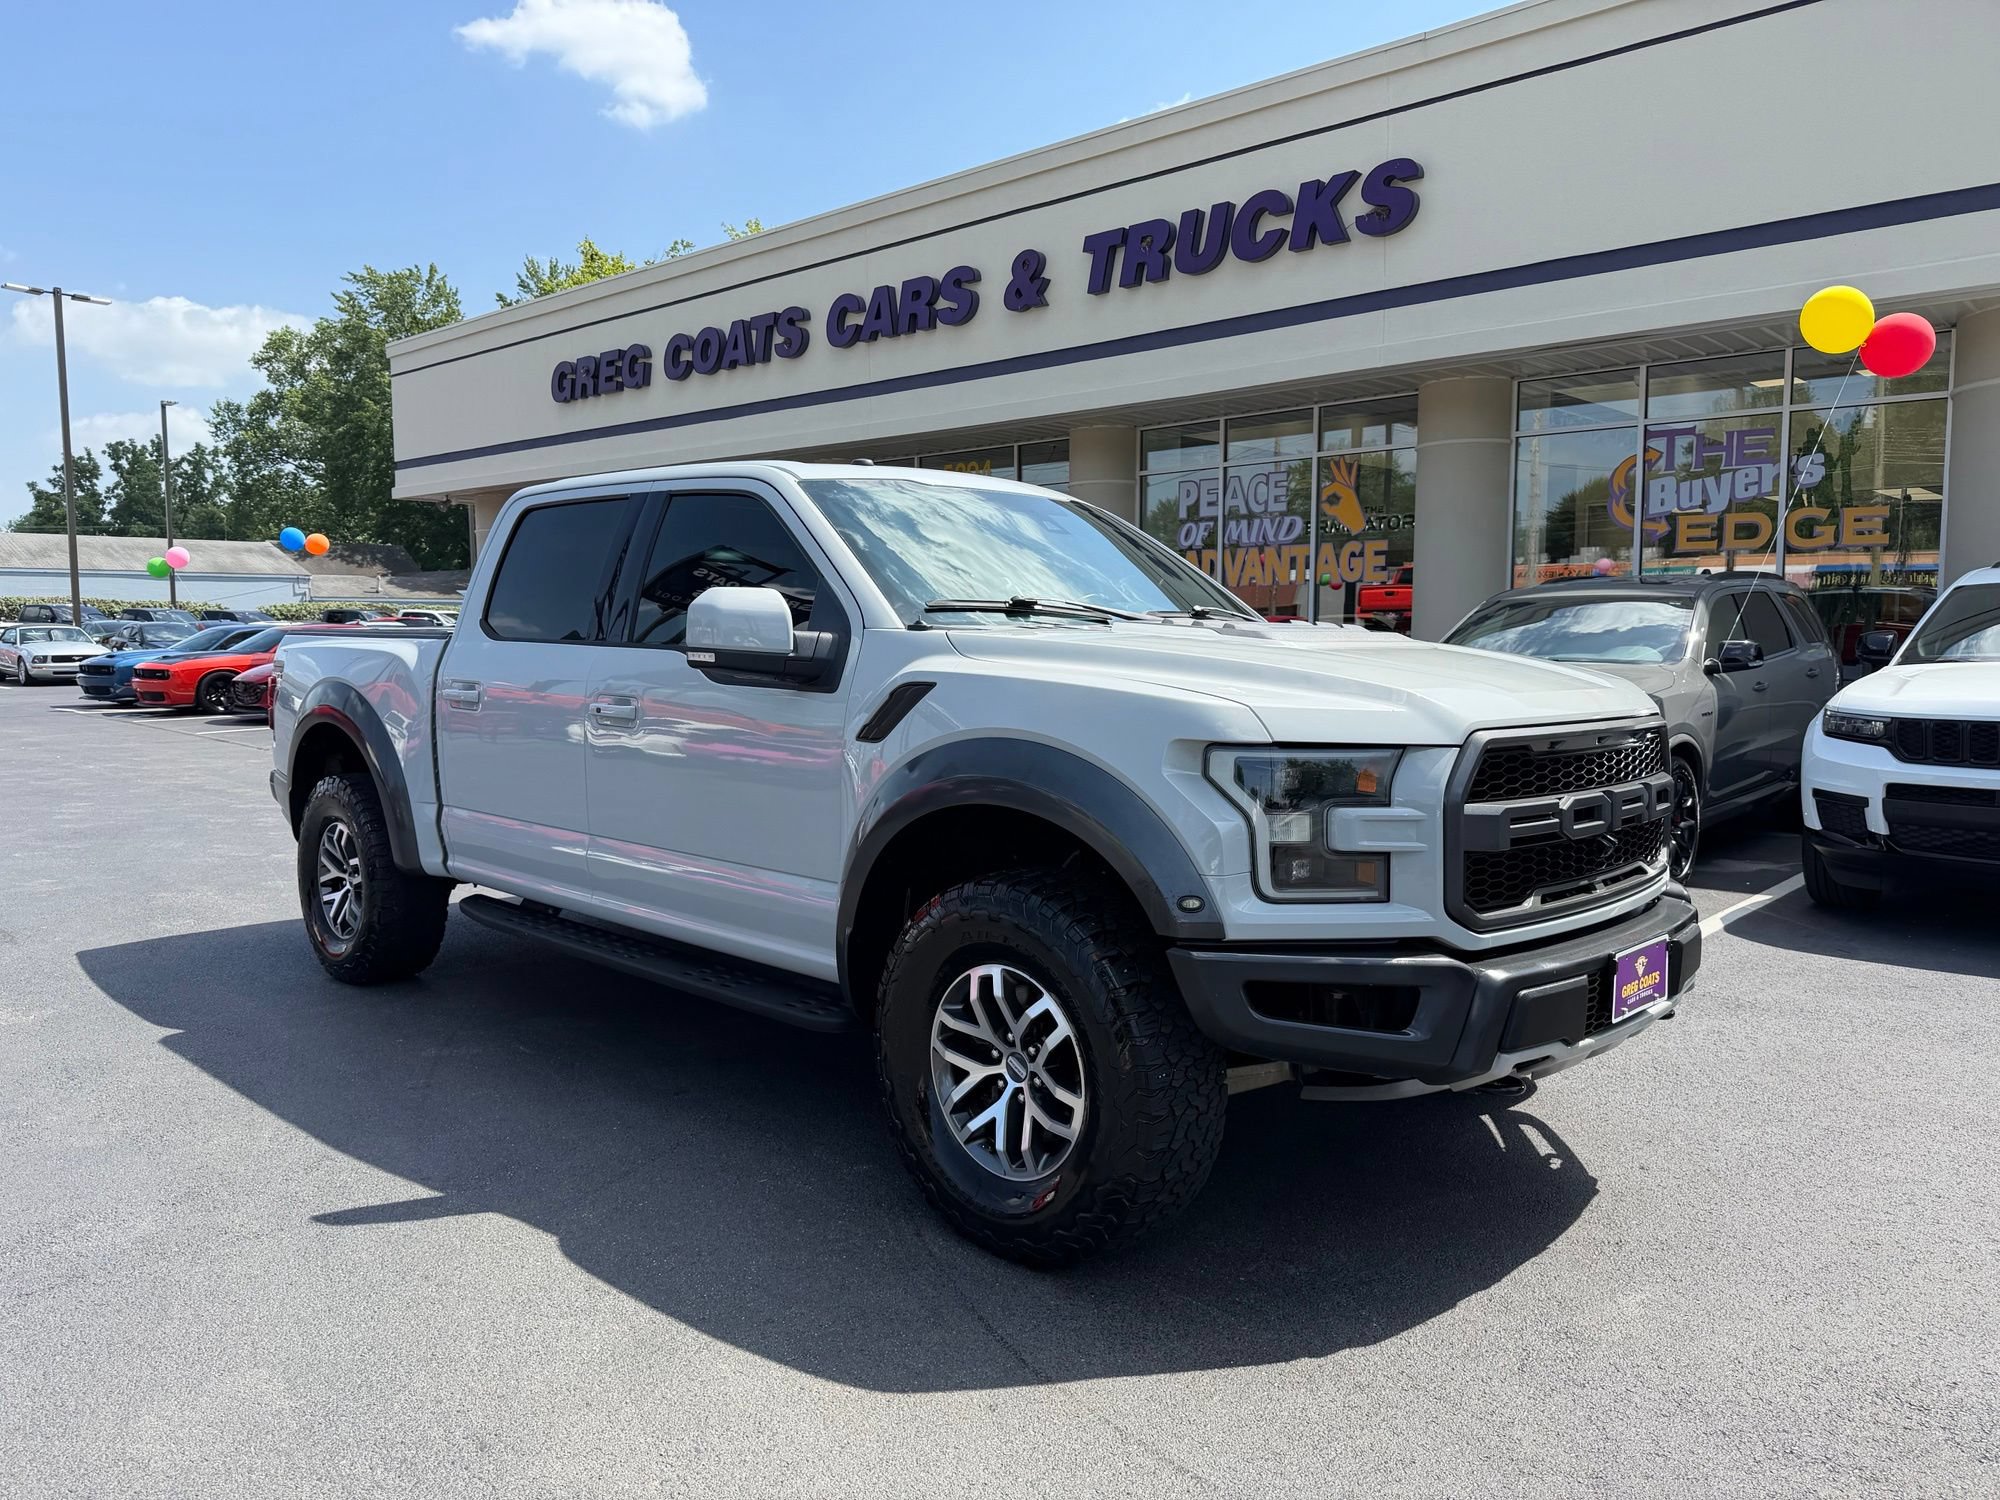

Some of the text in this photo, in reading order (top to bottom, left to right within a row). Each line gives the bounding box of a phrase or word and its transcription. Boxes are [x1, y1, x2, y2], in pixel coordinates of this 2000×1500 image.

[551, 158, 1425, 403] GREG COATS CARS & TRUCKS
[1646, 425, 1776, 474] THE
[1178, 471, 1288, 520] PEACE
[1178, 516, 1304, 549] OF MIND
[1674, 504, 1891, 554] EDGE
[1464, 771, 1674, 851] FORD
[1622, 970, 1660, 998] GREG COATS
